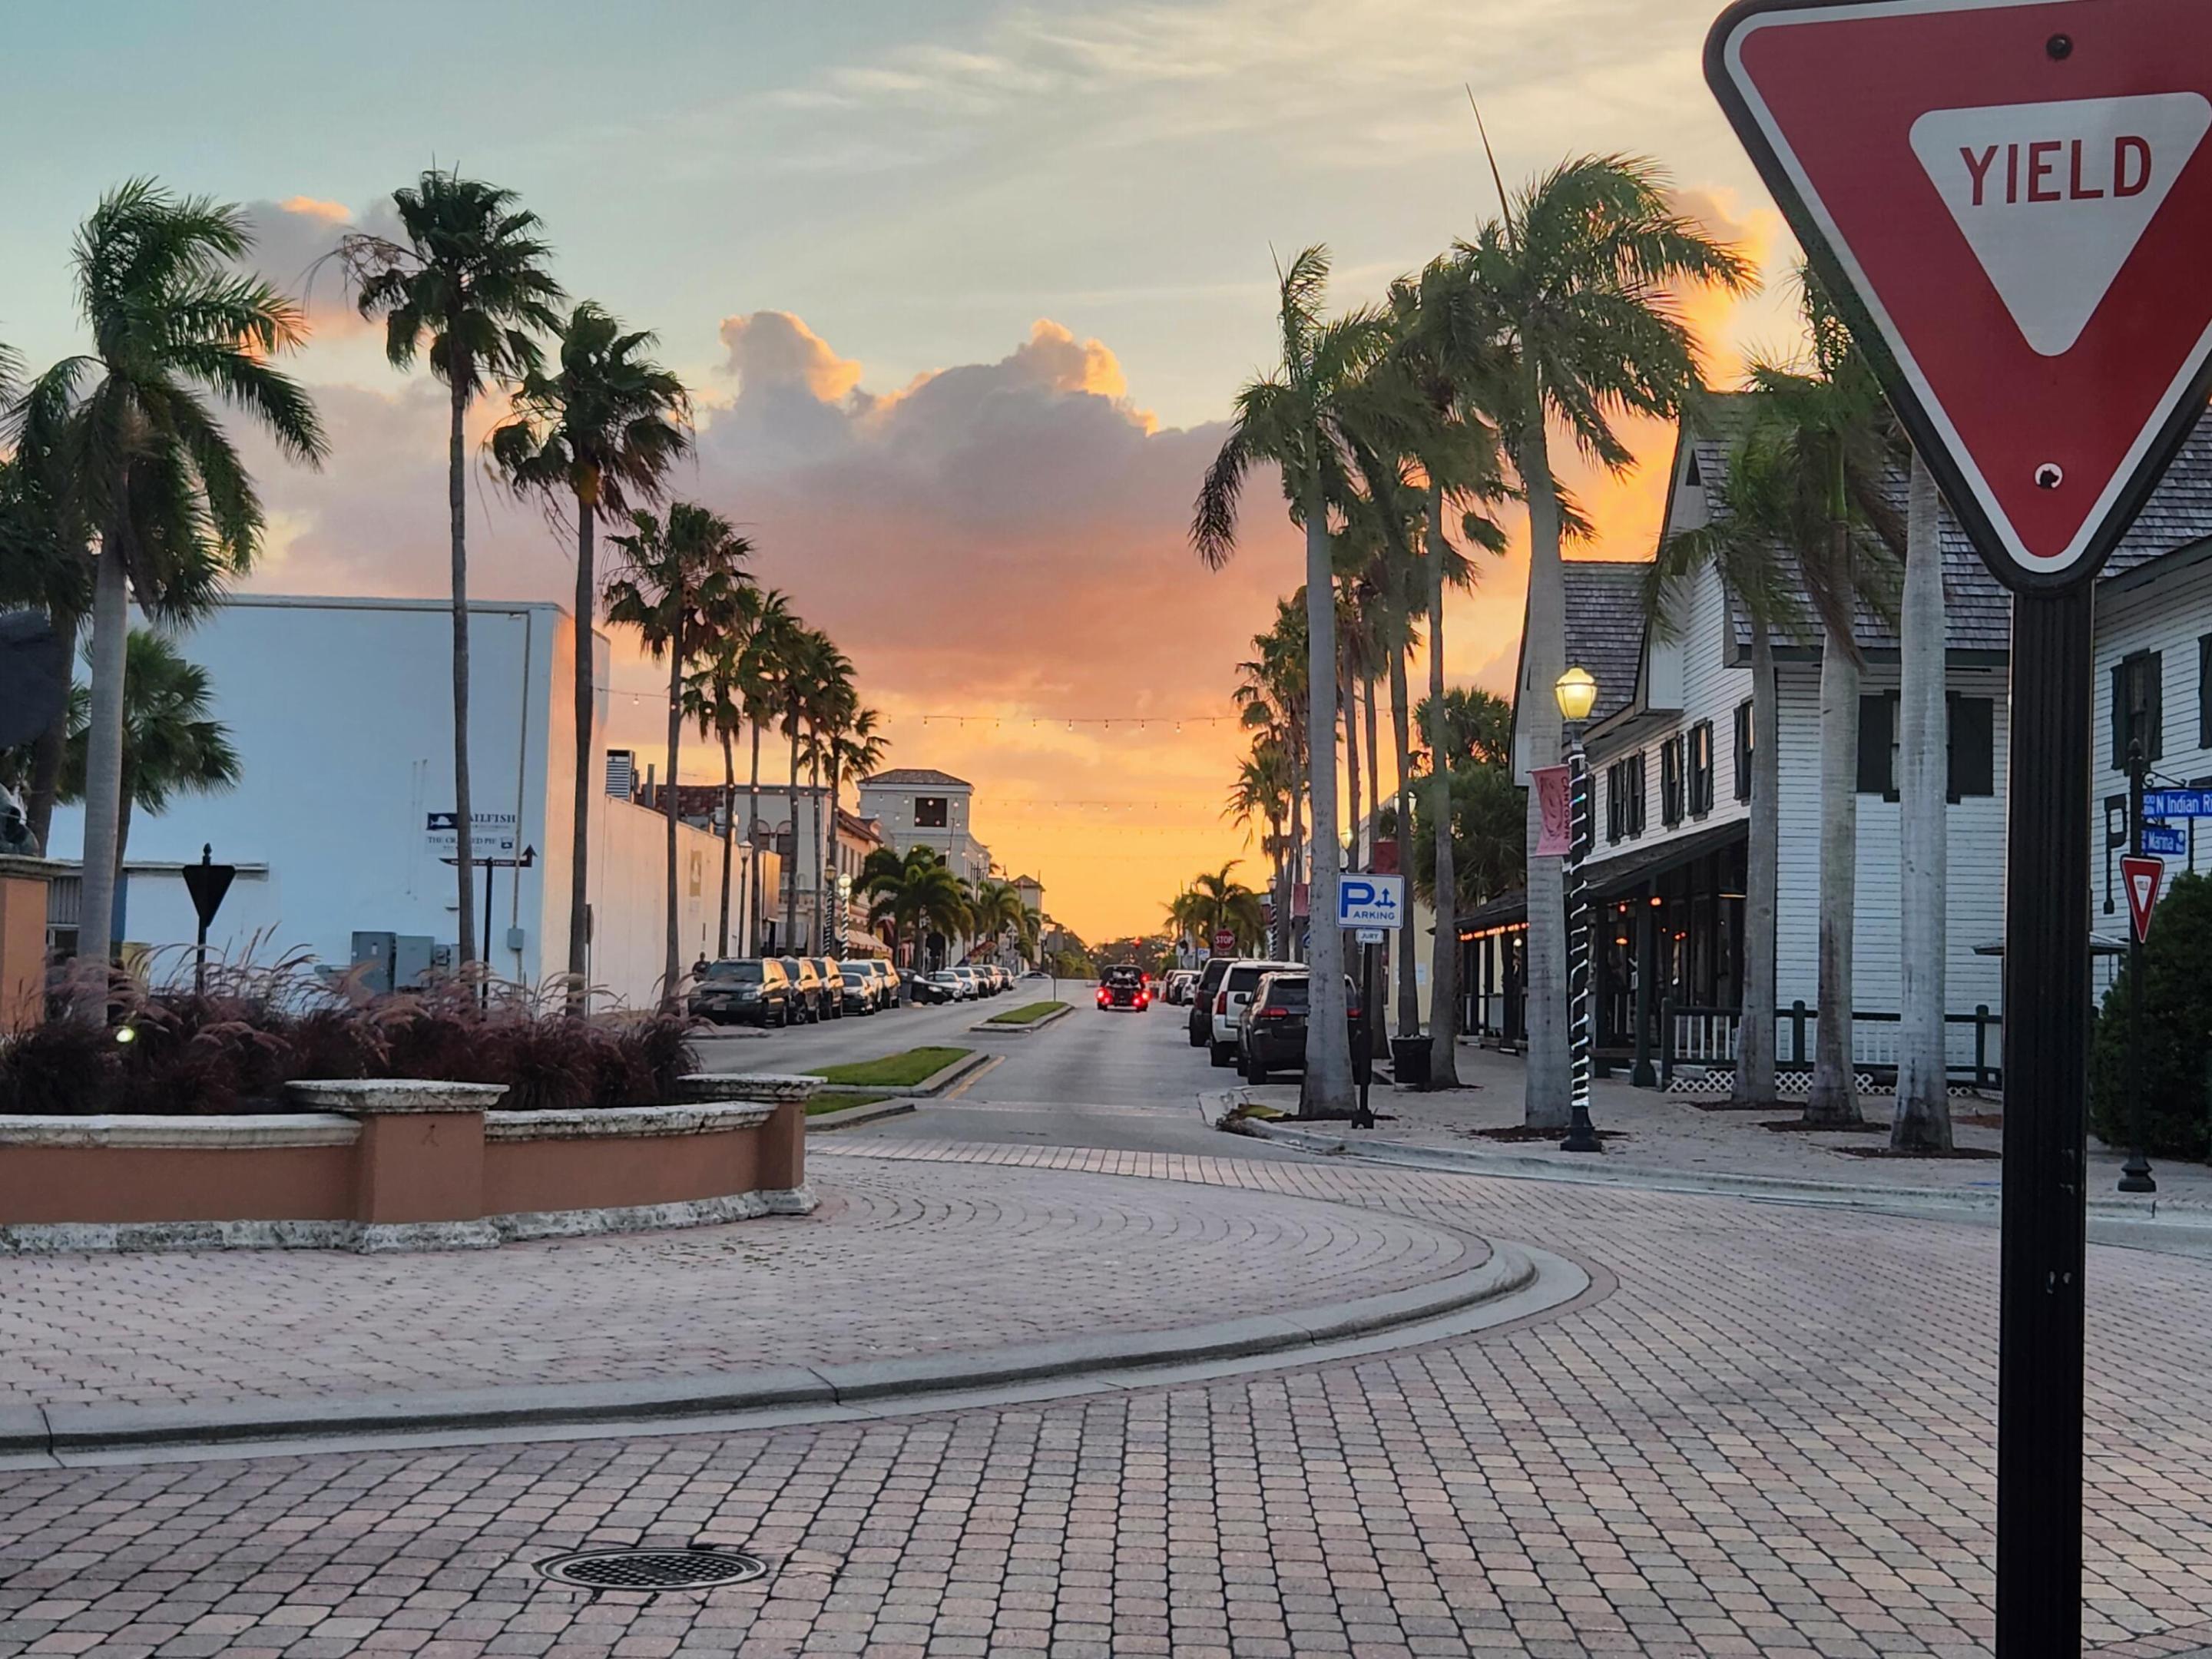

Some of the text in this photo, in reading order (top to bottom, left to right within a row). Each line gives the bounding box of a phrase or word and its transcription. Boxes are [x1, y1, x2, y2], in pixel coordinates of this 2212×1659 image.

[1959, 135, 2152, 207] YIELD
[2156, 795, 2164, 814] N
[2167, 794, 2200, 814] Indian
[469, 813, 516, 823] ILFISH
[2148, 832, 2174, 851] Marina
[1340, 882, 1396, 920] PARKING
[1215, 935, 1233, 944] STOP
